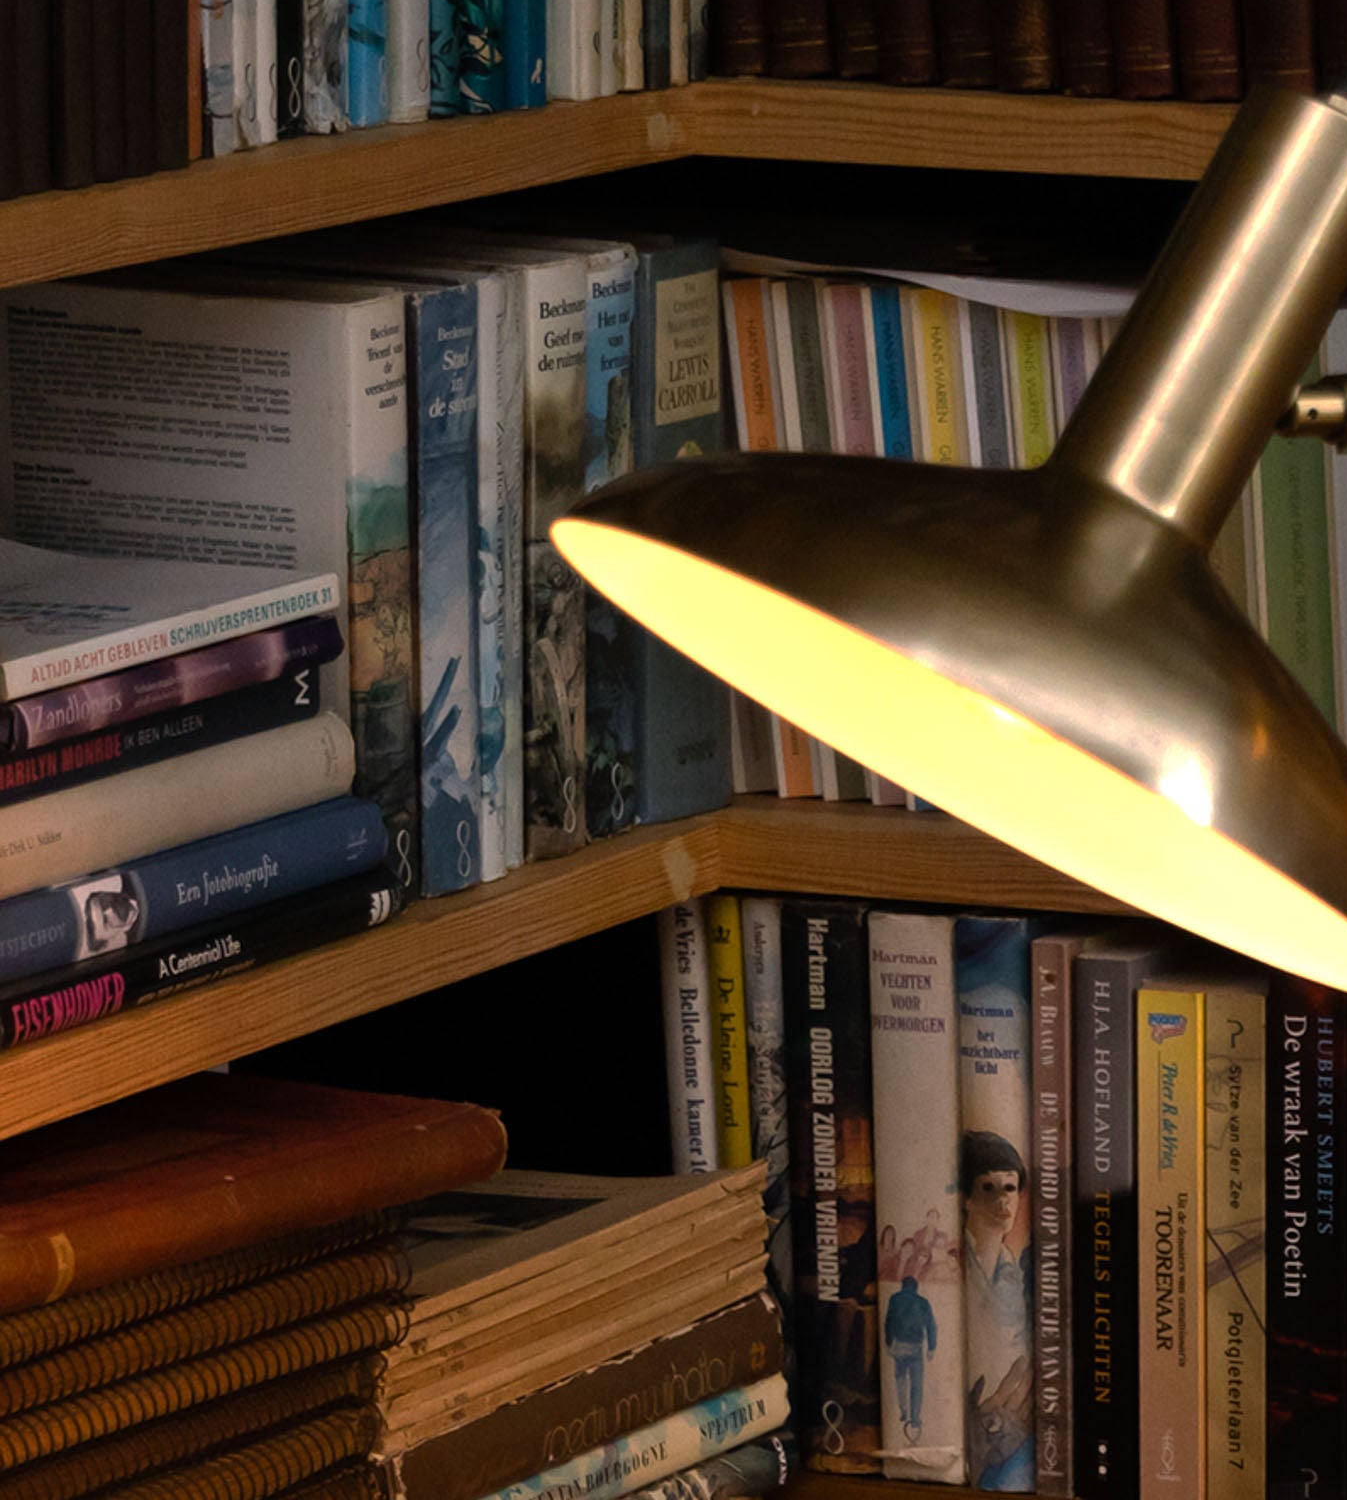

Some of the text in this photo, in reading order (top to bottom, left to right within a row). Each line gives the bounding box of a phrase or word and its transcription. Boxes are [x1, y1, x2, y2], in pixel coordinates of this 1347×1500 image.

[659, 379, 717, 413] CARROLL
[669, 353, 711, 383] LEWIS
[30, 586, 333, 684] ALTIJD ACHT GEBLEVEN SCHRIJVERSPRENTENBOEK 31
[176, 854, 280, 904] Een fotobiografie
[10, 971, 126, 1038] EISENHOWER
[807, 919, 840, 1302] Hartman OORLOG ZONDER VRIENDEN
[1284, 1014, 1307, 1299] De wraak van Poetin
[1316, 1017, 1335, 1235] HUBERT SMEETS
[1092, 979, 1112, 1404] H.J.A. HOFLAND TEGELS LICHTEN
